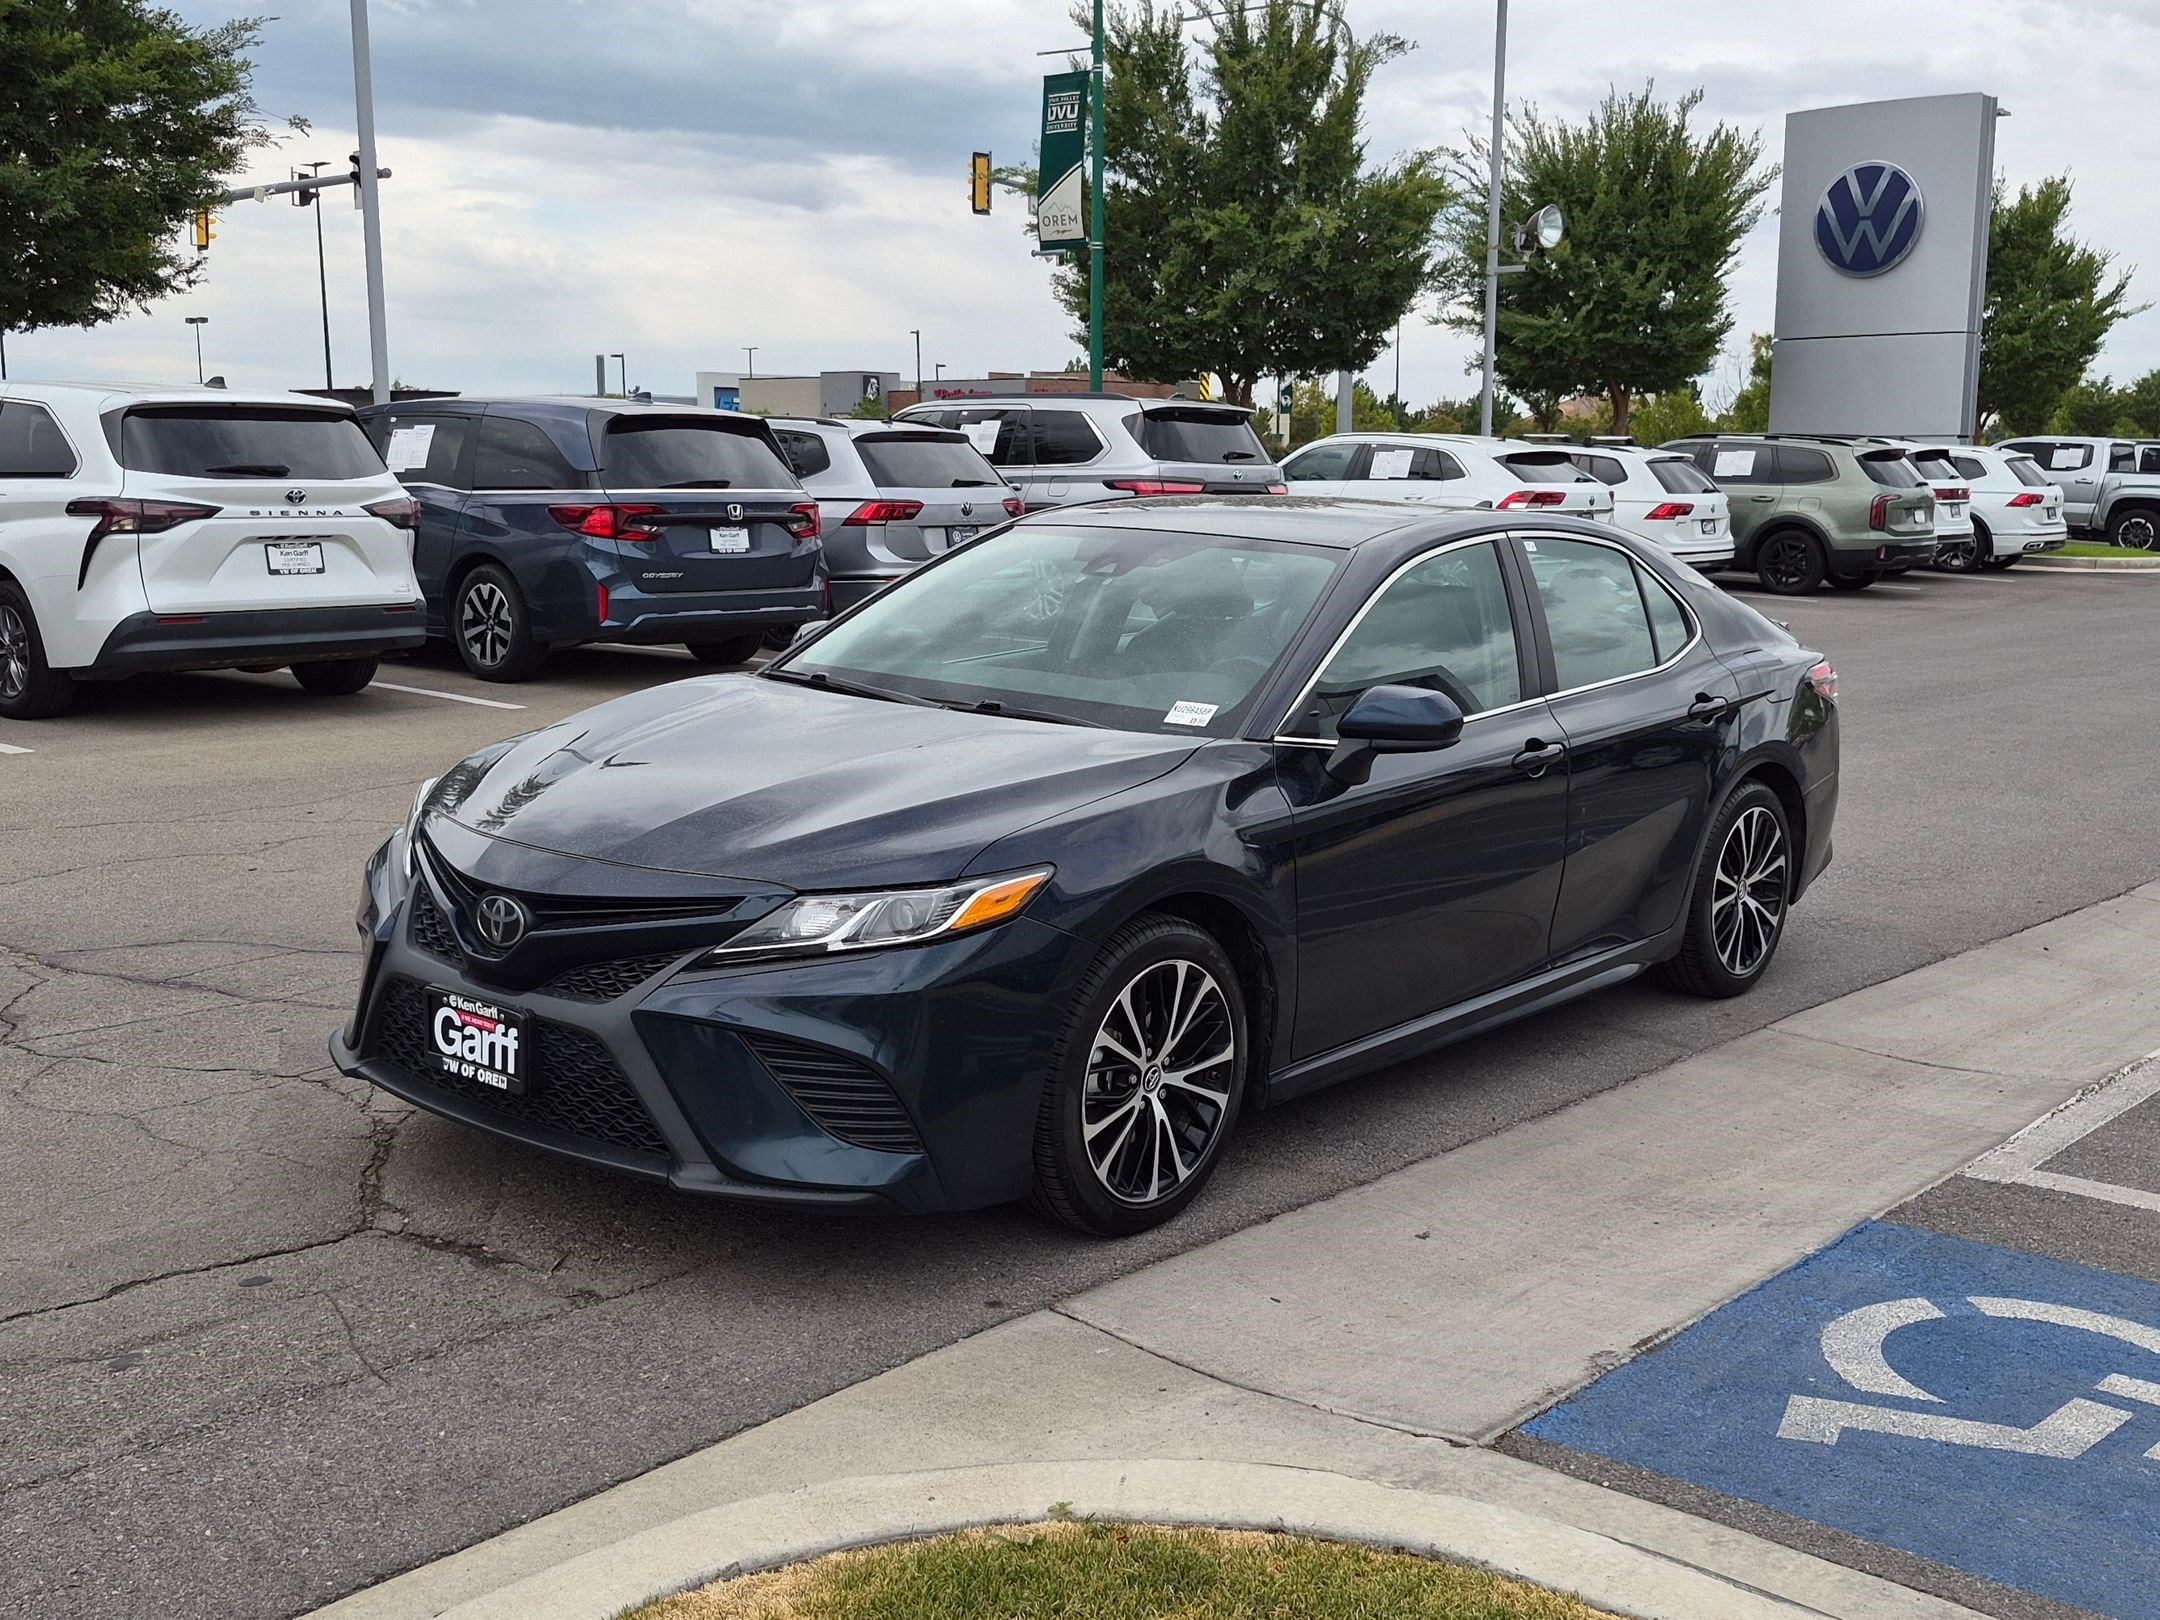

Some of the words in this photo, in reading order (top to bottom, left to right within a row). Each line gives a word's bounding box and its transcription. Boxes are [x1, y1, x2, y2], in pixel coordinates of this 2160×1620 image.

[1047, 104, 1079, 121] UVU
[1042, 214, 1078, 227] OREM
[293, 549, 309, 557] Garff
[458, 996, 475, 1012] Ken
[476, 1002, 498, 1019] Garff
[434, 1007, 518, 1074] Garff
[461, 1063, 476, 1078] OF
